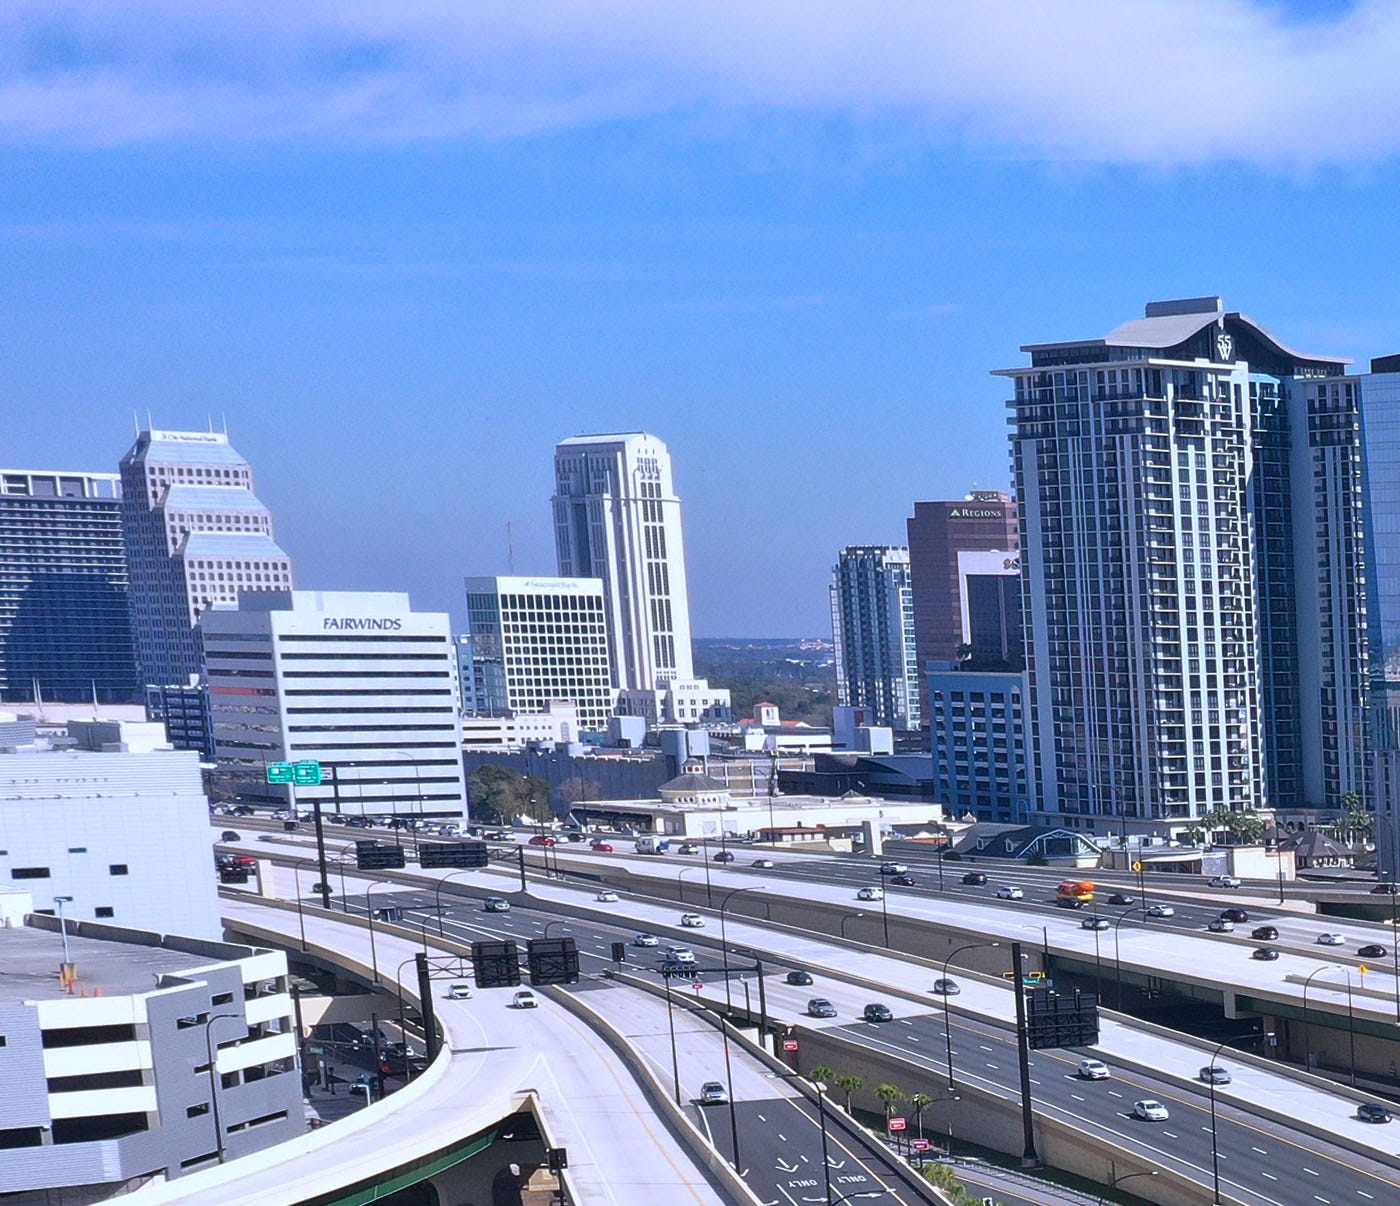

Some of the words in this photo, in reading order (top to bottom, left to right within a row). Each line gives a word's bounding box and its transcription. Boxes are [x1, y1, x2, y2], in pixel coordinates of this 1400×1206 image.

[962, 508, 1001, 517] REGIONS
[323, 618, 402, 630] FAIRWINDS
[788, 1179, 817, 1188] ONLY
[837, 1175, 867, 1184] ONLY
